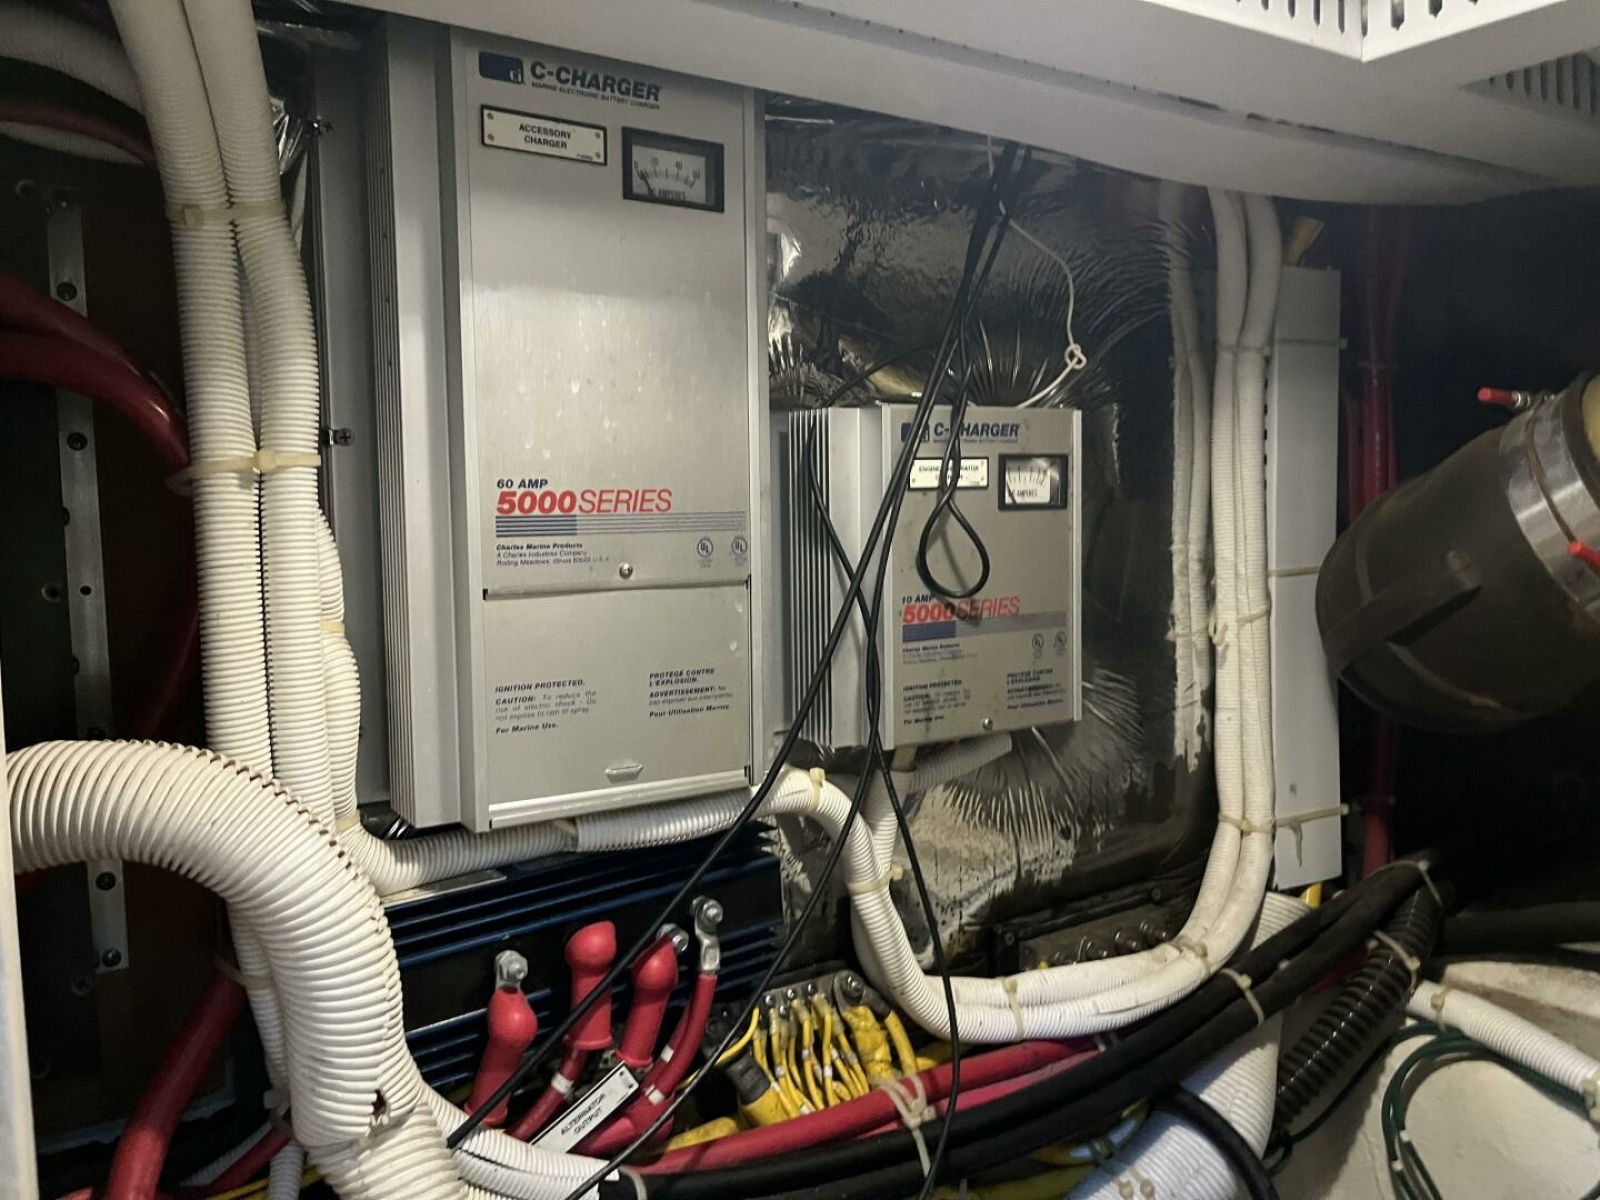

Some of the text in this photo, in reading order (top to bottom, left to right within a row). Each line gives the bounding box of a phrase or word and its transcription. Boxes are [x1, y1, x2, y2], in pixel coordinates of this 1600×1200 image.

[530, 60, 661, 102] C-CHARGER
[519, 123, 572, 139] ACCESSORY
[524, 136, 567, 149] CHARGER
[496, 478, 549, 490] 60 AMP
[902, 595, 913, 603] 10
[495, 683, 533, 693] IGNITION
[511, 724, 540, 732] Marine
[560, 1092, 606, 1135] ALTERNATOR
[573, 1107, 602, 1134] OUTPUT
